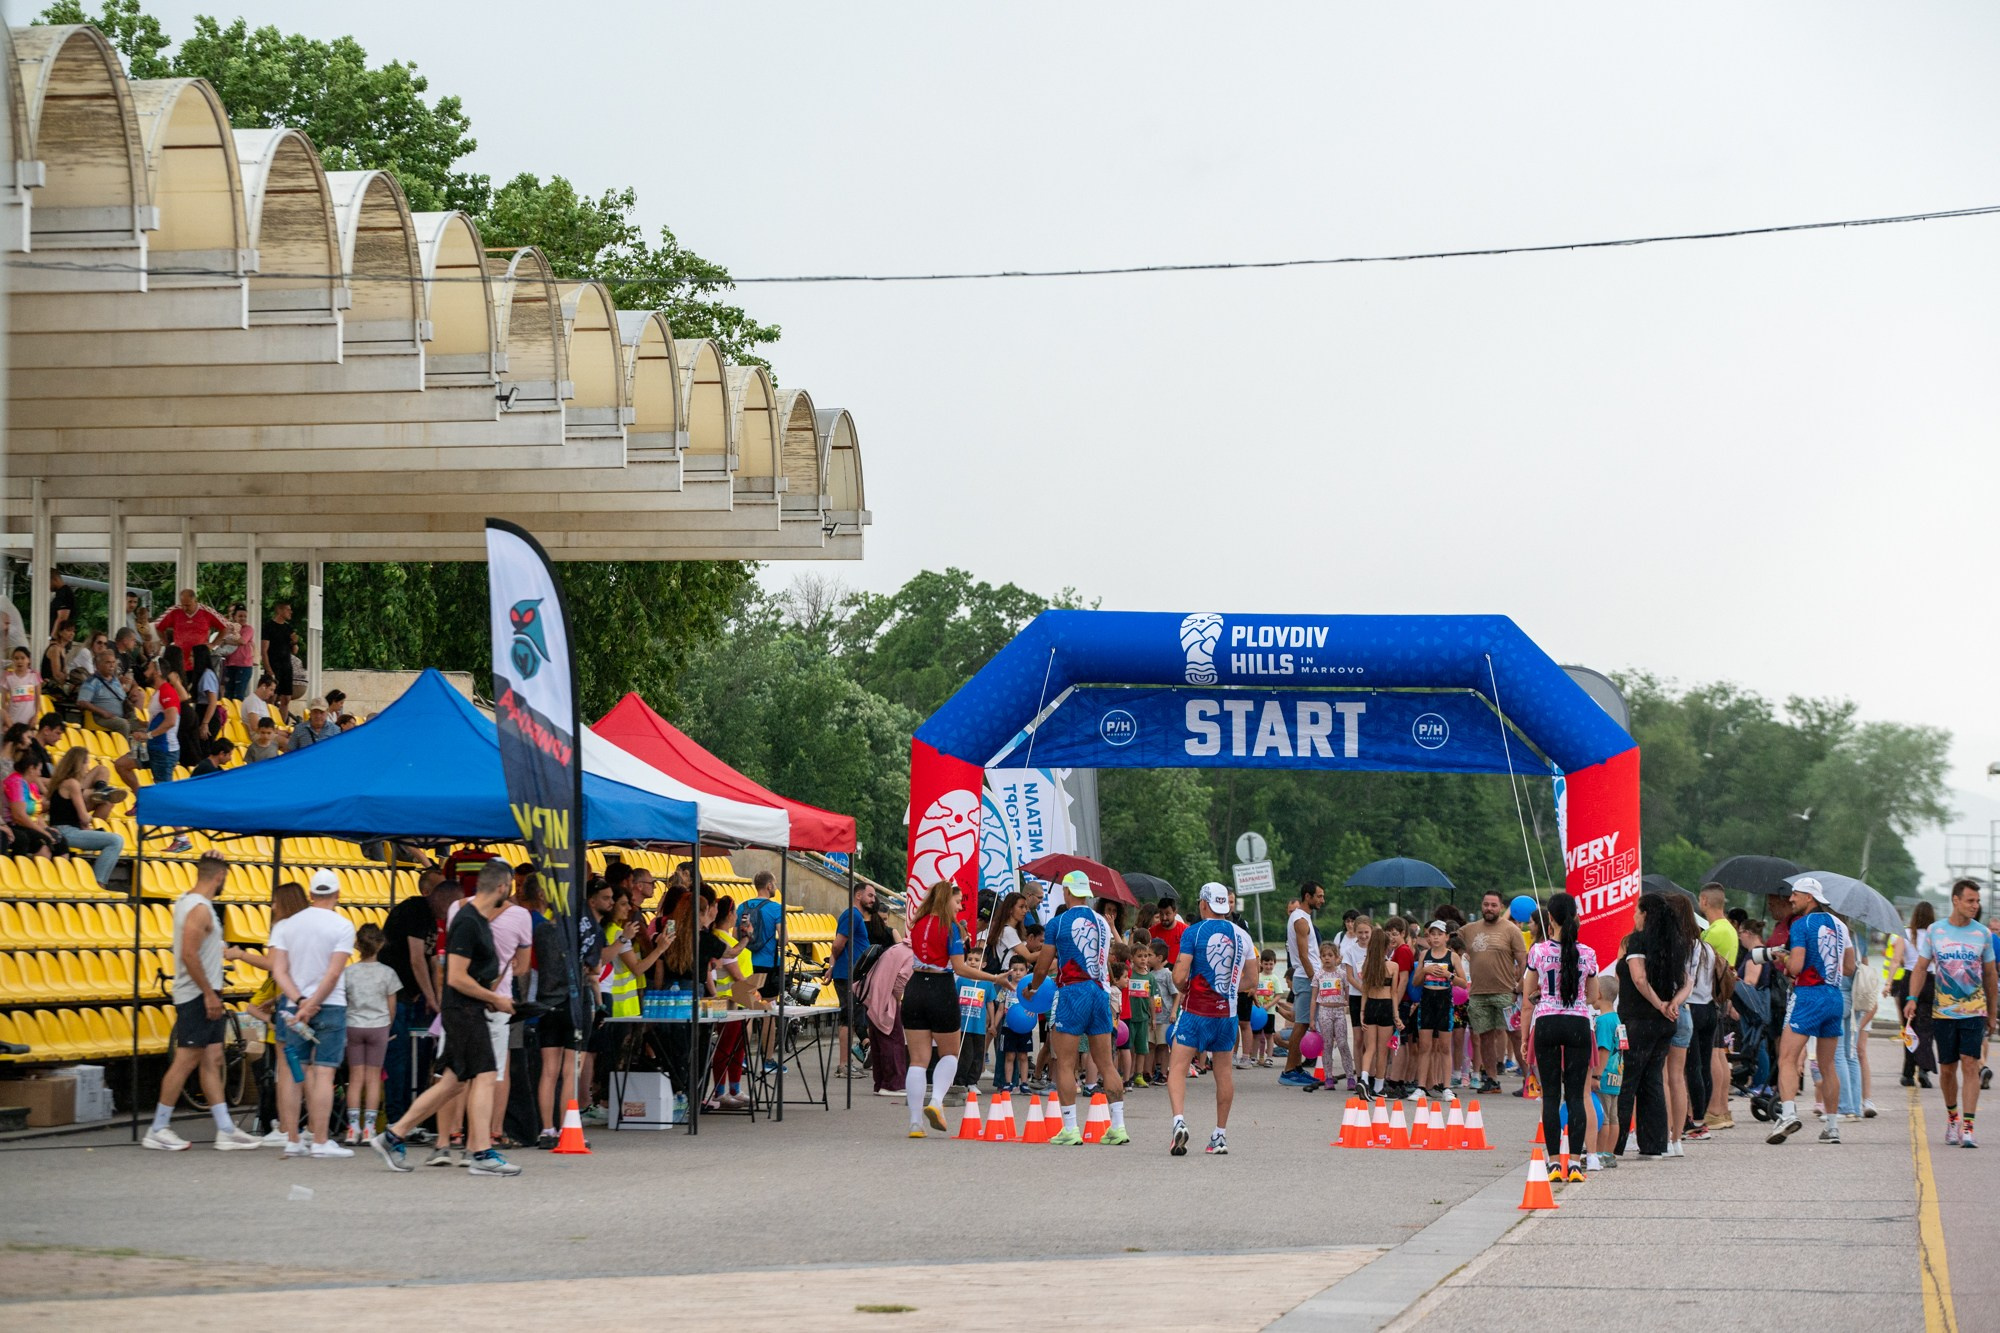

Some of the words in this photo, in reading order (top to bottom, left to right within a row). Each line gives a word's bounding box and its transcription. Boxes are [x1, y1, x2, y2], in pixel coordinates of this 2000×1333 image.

[1231, 625, 1330, 648] PLOVDIV
[1231, 653, 1295, 675] HILLS
[1300, 656, 1314, 664] IN
[1301, 666, 1365, 674] MARKOVO
[1106, 721, 1131, 733] P/H
[1184, 699, 1367, 758] START
[1418, 724, 1443, 736] P/H
[1583, 847, 1636, 891] STEP
[1574, 868, 1640, 917] ATTERS
